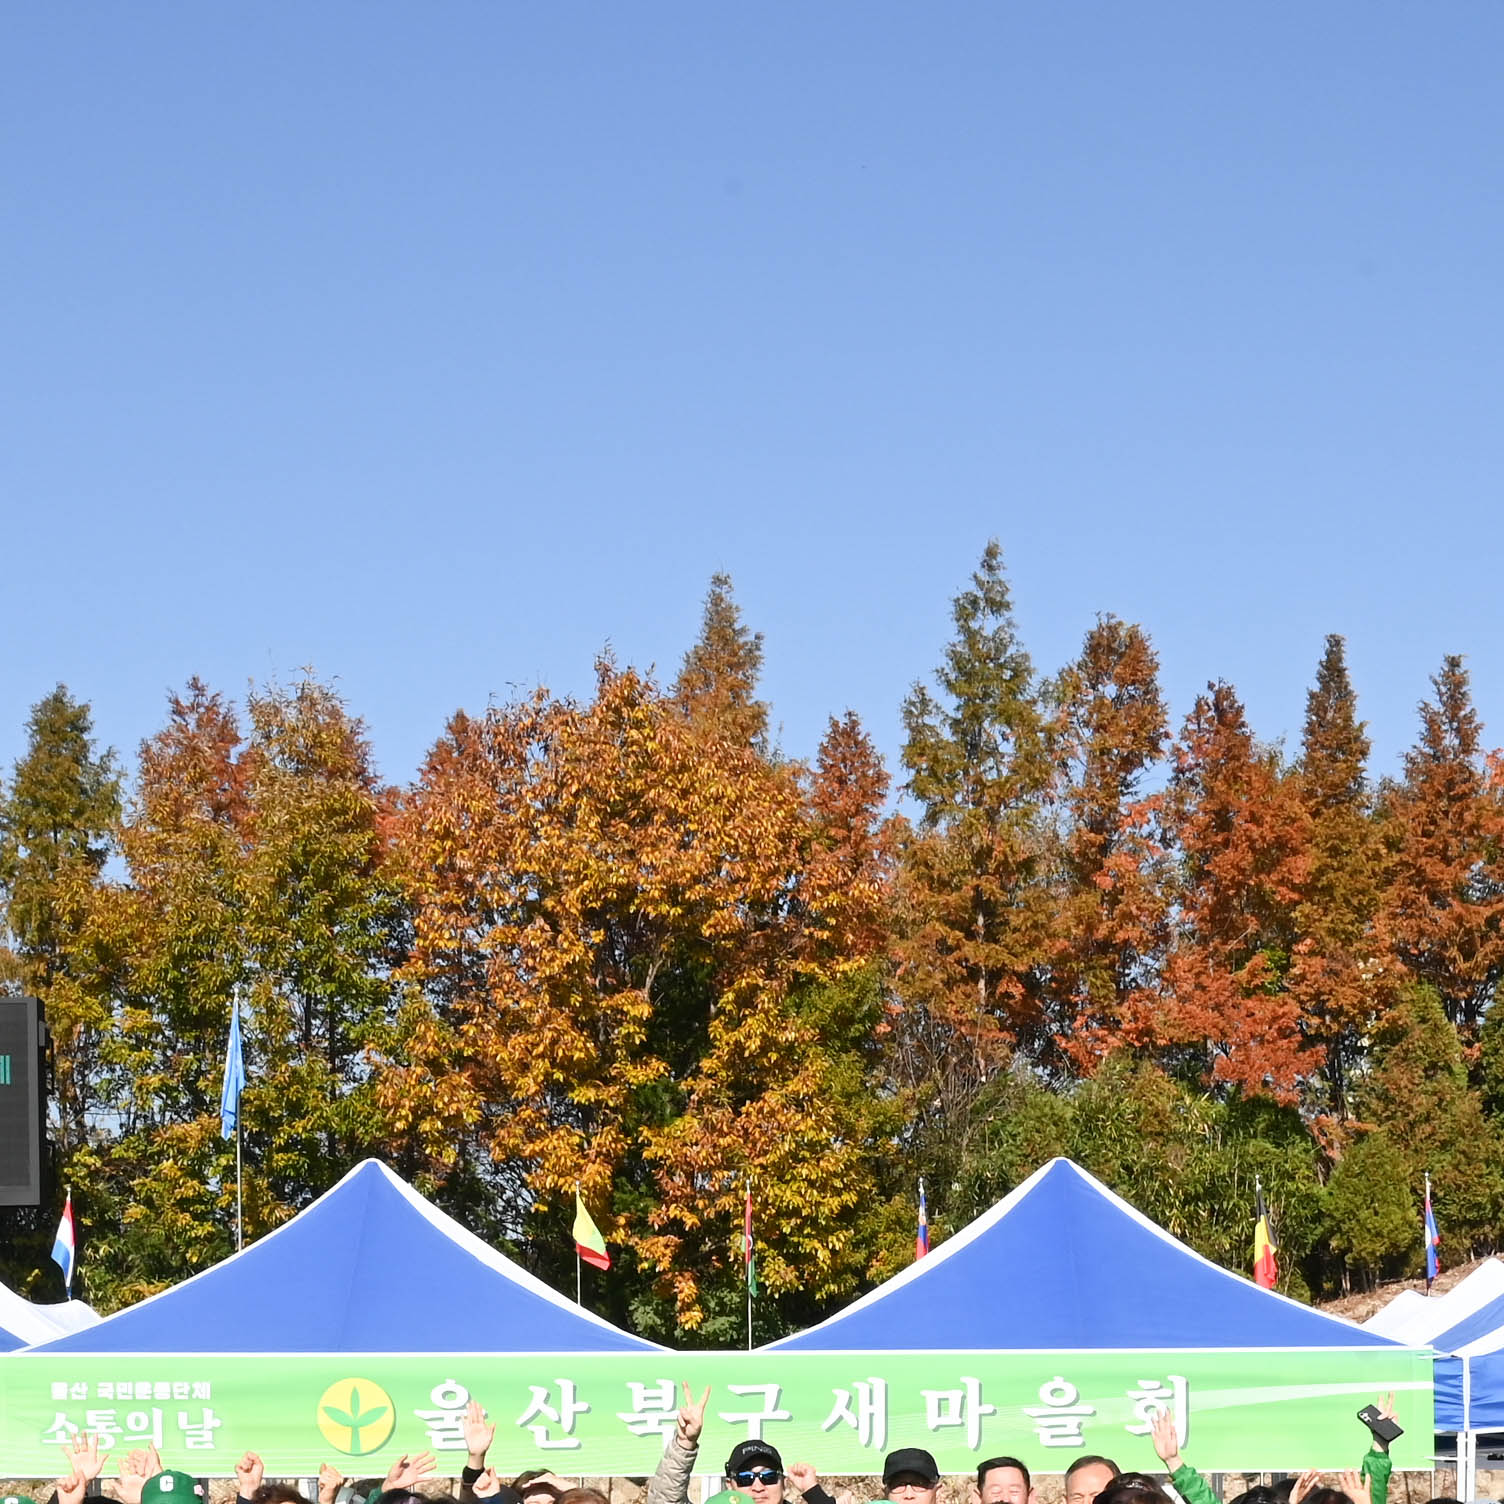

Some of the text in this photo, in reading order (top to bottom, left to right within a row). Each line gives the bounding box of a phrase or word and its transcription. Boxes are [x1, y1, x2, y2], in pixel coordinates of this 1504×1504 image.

[42, 1407, 223, 1450] 소통의 날
[159, 1475, 174, 1492] C
